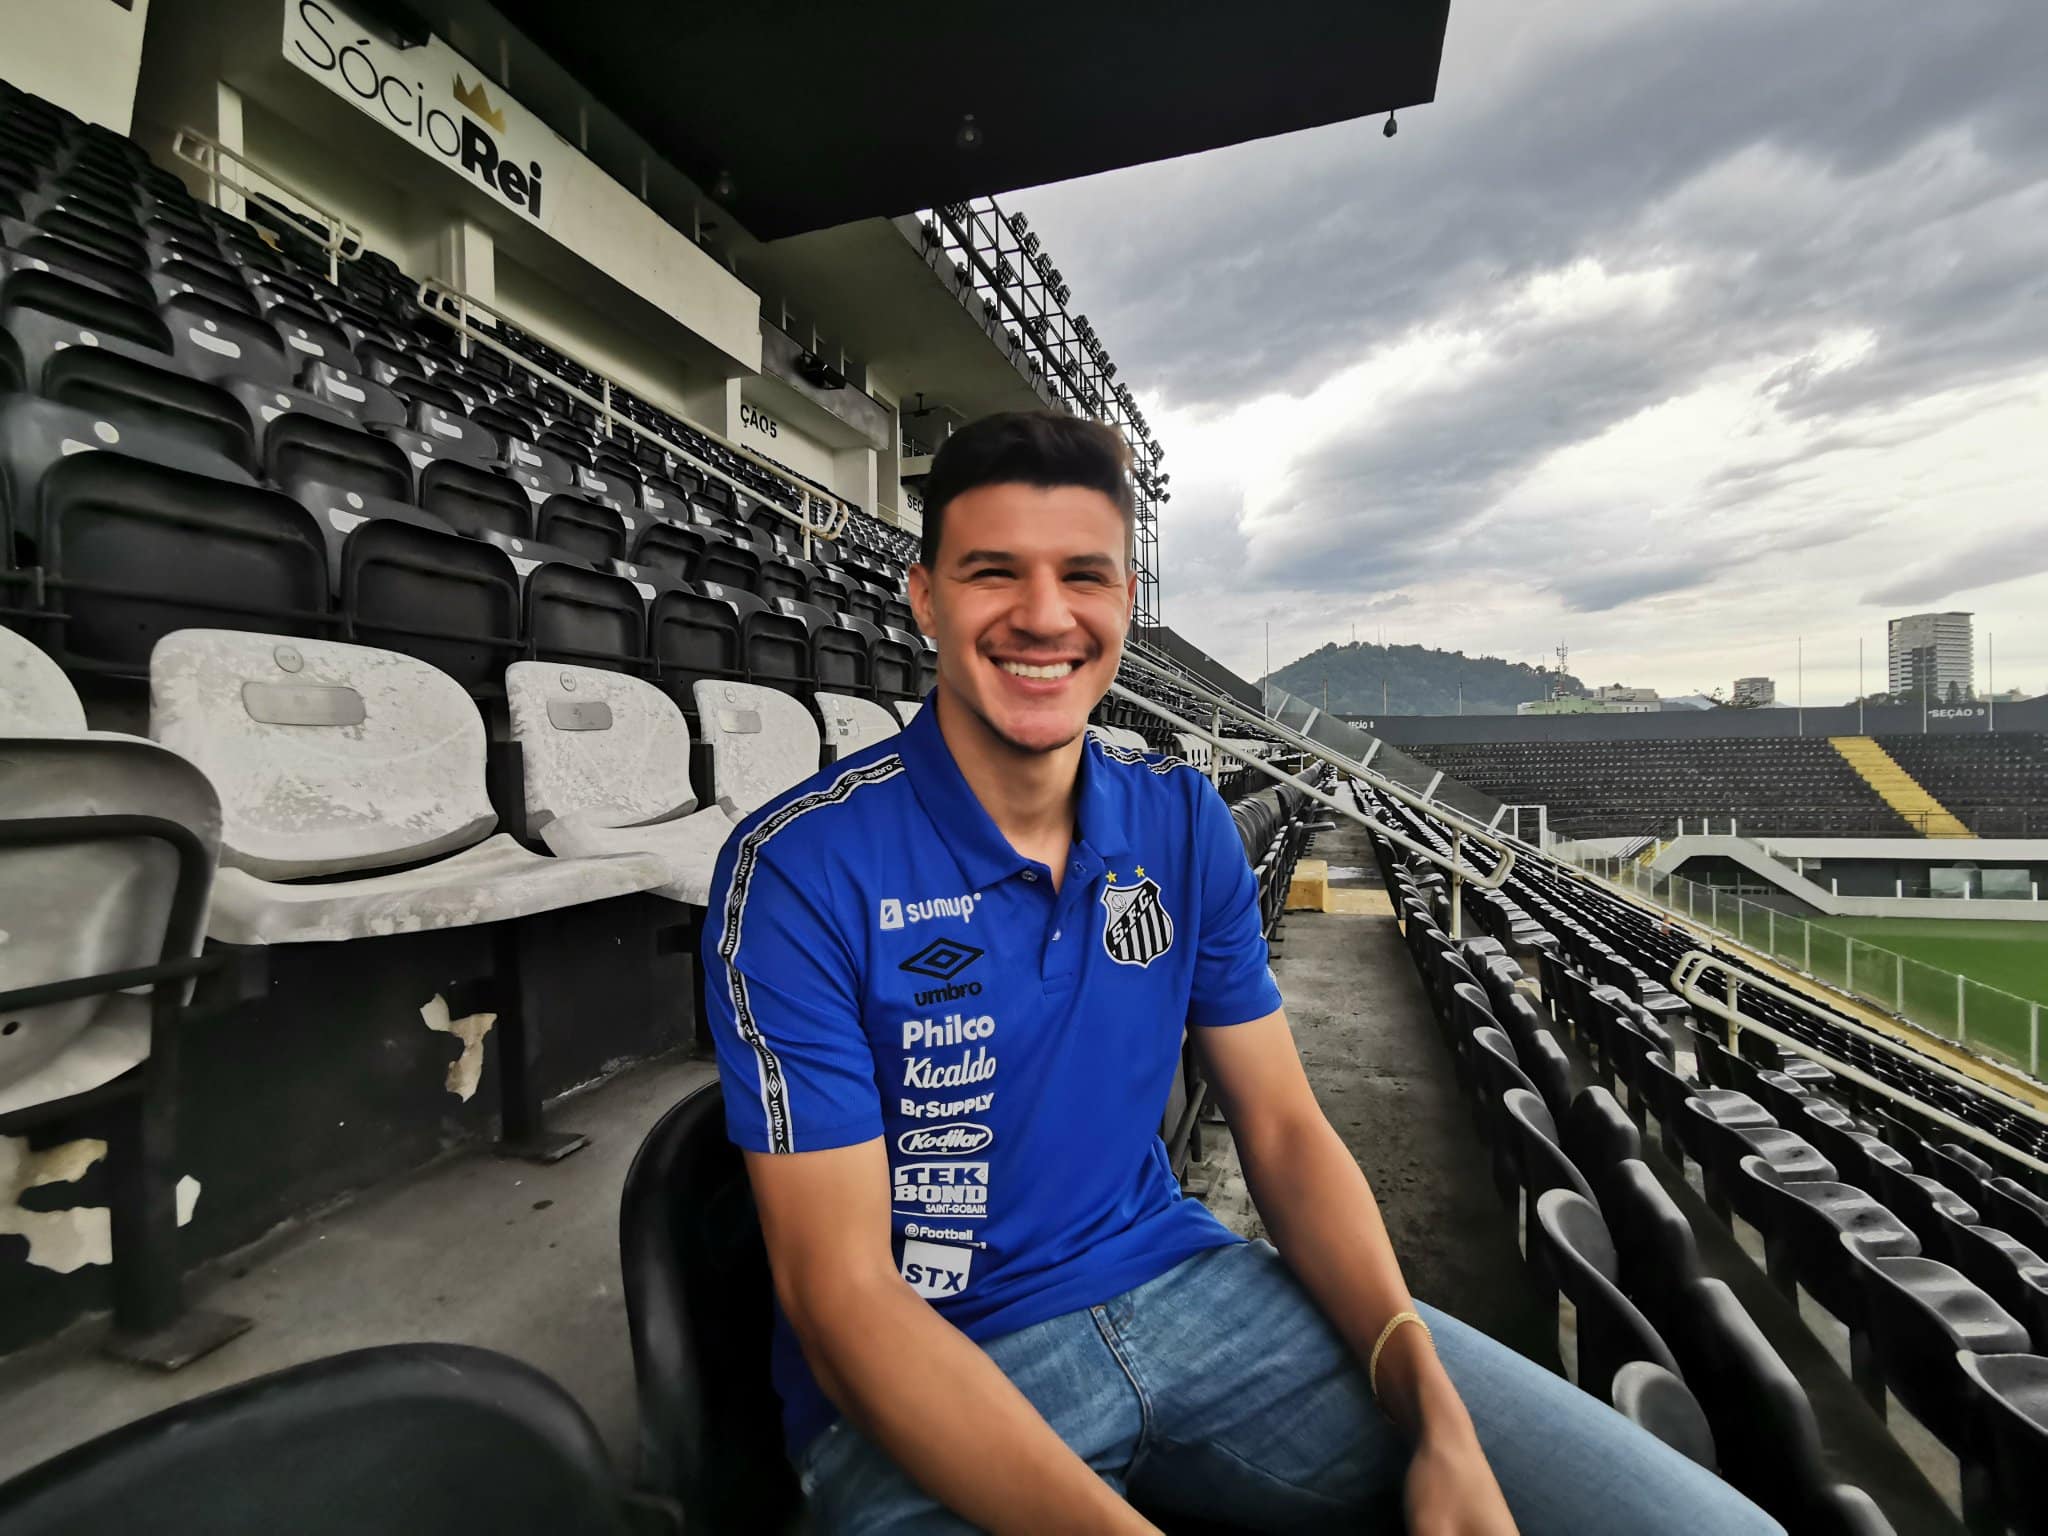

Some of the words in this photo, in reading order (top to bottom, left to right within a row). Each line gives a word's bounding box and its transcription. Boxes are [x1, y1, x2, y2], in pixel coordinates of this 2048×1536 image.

[769, 805, 799, 828] umbro
[737, 847, 751, 883] umbro
[723, 917, 737, 955] umbro
[734, 983, 747, 1021] umbro
[914, 981, 983, 1007] umbro
[903, 1013, 996, 1050] Philco
[903, 1046, 996, 1089] Kicaldo
[770, 1100, 784, 1141] umbro
[908, 1129, 987, 1151] Kodilar
[900, 1167, 984, 1185] TEK
[894, 1184, 987, 1204] BOND
[925, 1204, 987, 1214] SAINT-GOBAIN
[904, 1263, 964, 1291] STX
